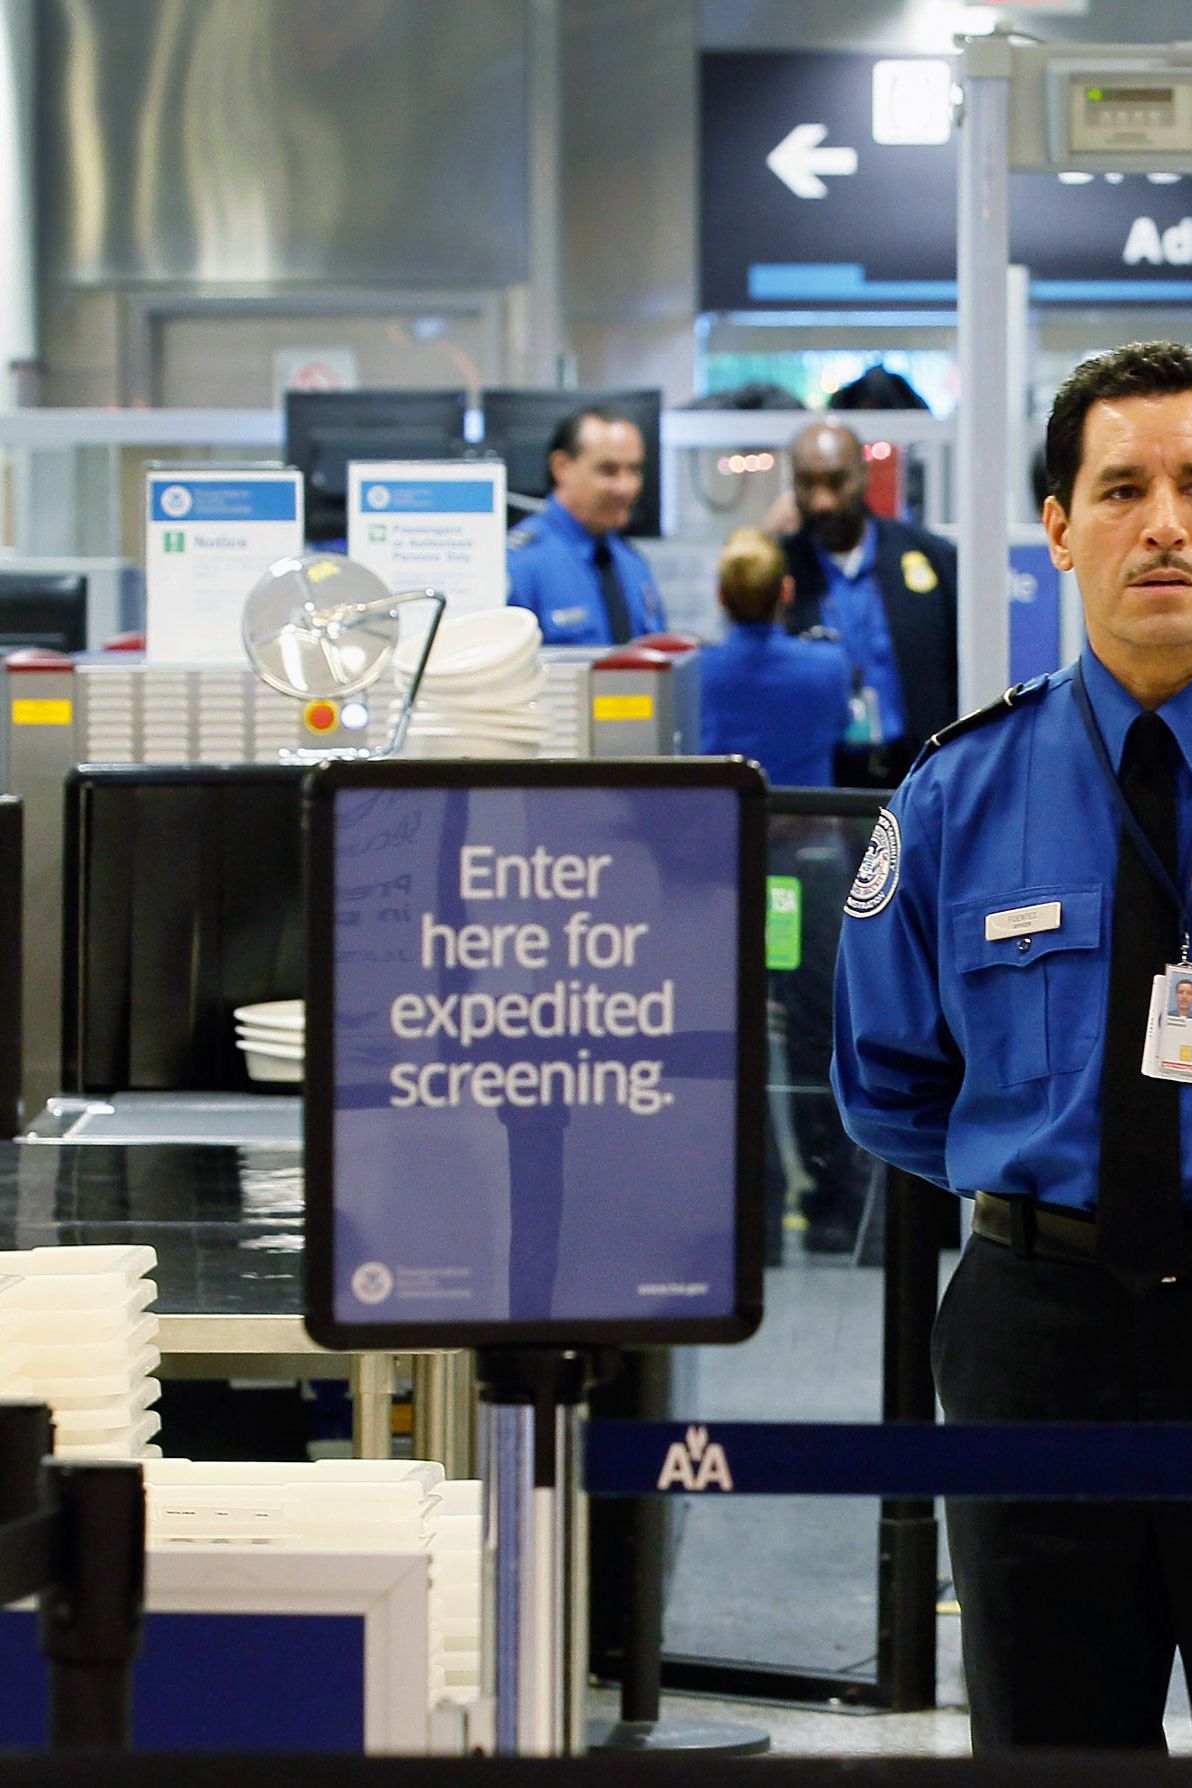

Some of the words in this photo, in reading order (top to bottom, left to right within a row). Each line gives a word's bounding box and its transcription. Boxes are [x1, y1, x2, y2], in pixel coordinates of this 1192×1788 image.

[461, 846, 613, 900] Enter
[422, 912, 550, 969] here
[563, 911, 649, 968] for
[389, 979, 676, 1048] expedited
[389, 1048, 676, 1115] screening.
